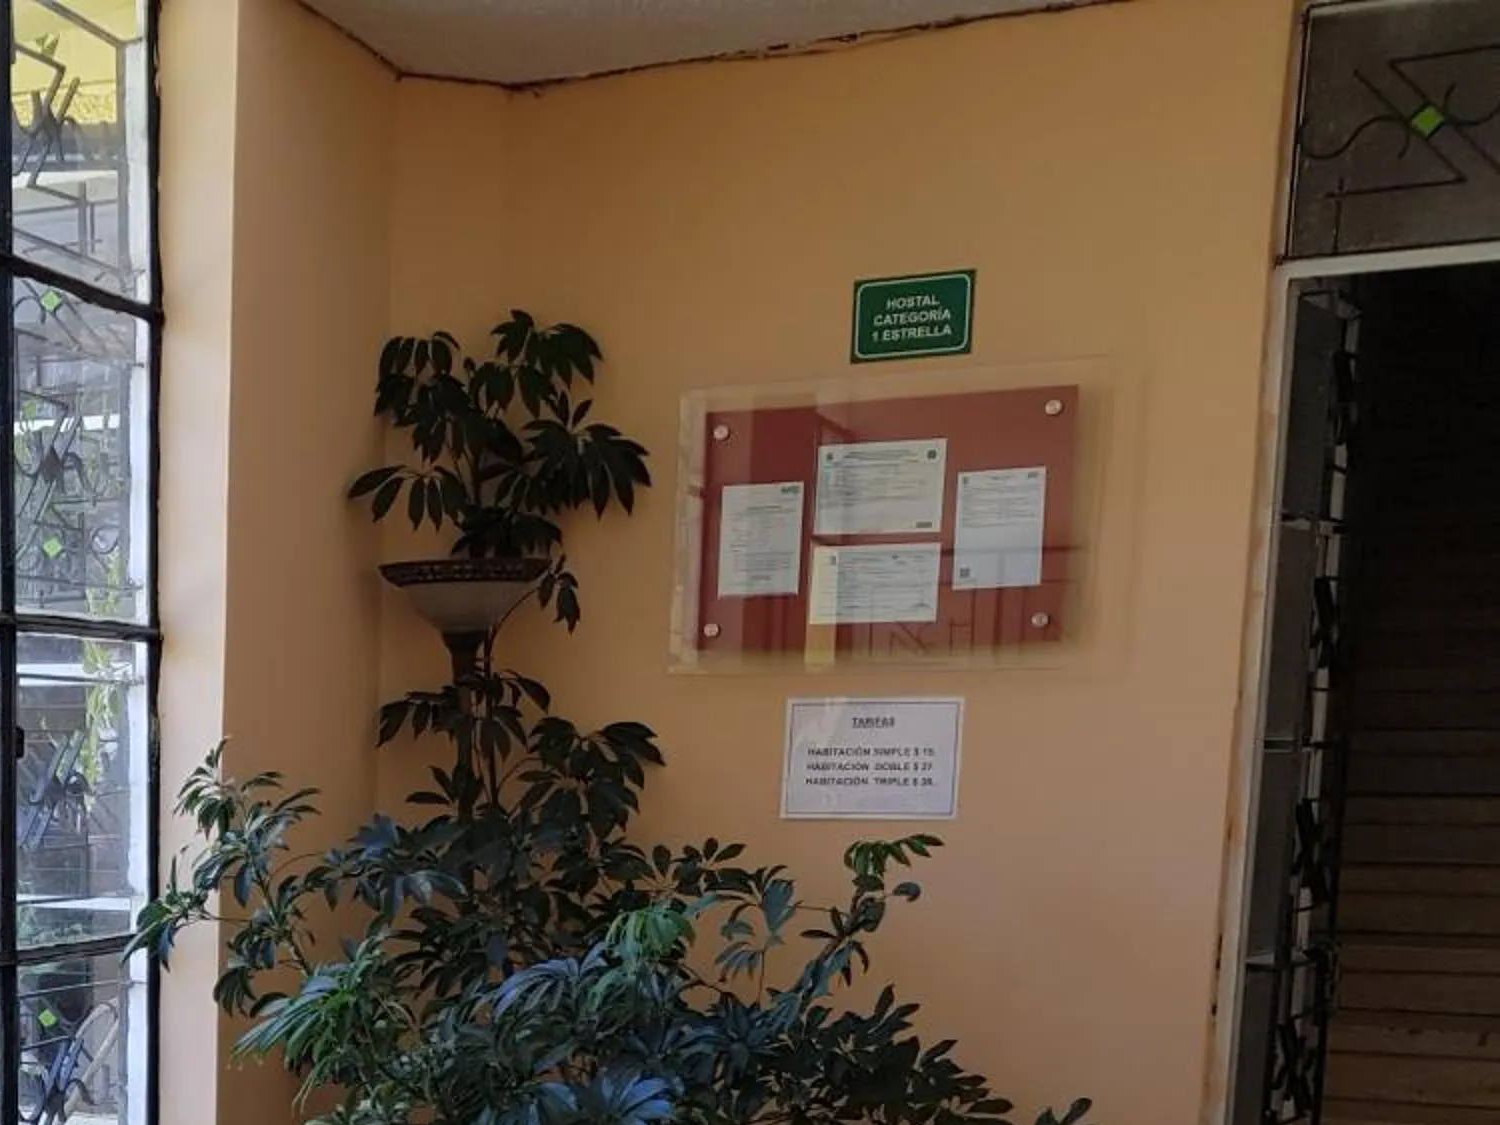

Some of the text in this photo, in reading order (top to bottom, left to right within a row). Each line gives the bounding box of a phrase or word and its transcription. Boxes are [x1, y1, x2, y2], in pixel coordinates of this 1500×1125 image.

[886, 294, 940, 311] HOSTAL
[873, 307, 952, 327] CATEGORÍA
[872, 324, 952, 342] 1 ESTRELLA
[872, 747, 910, 757] SIMPLE
[874, 762, 910, 771] DOBLE
[873, 776, 909, 786] TRIPLE
